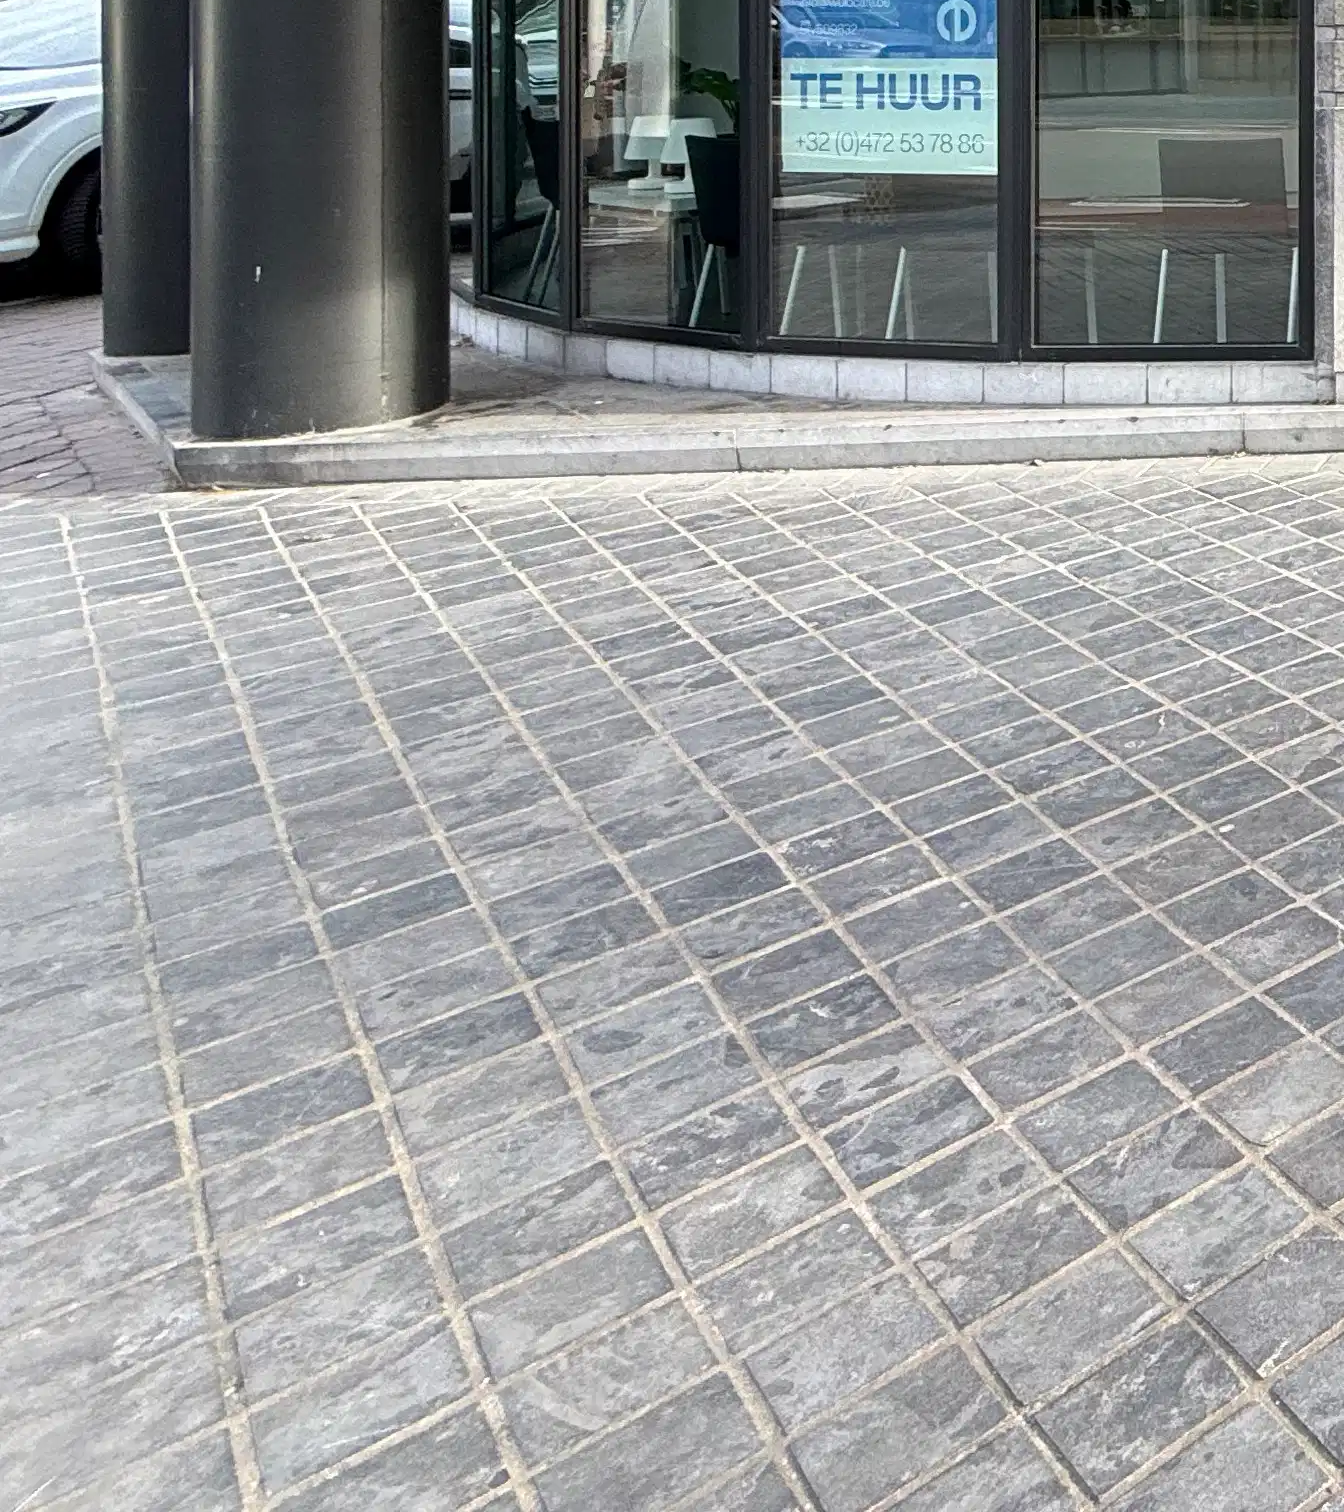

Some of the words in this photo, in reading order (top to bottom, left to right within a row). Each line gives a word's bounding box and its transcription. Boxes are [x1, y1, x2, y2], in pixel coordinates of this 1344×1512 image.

[790, 73, 843, 109] TE
[856, 73, 982, 110] HUUR
[796, 131, 830, 152] +32
[835, 130, 895, 156] (0)472
[900, 133, 925, 153] 53
[929, 133, 953, 154] 78
[957, 133, 985, 154] 86
